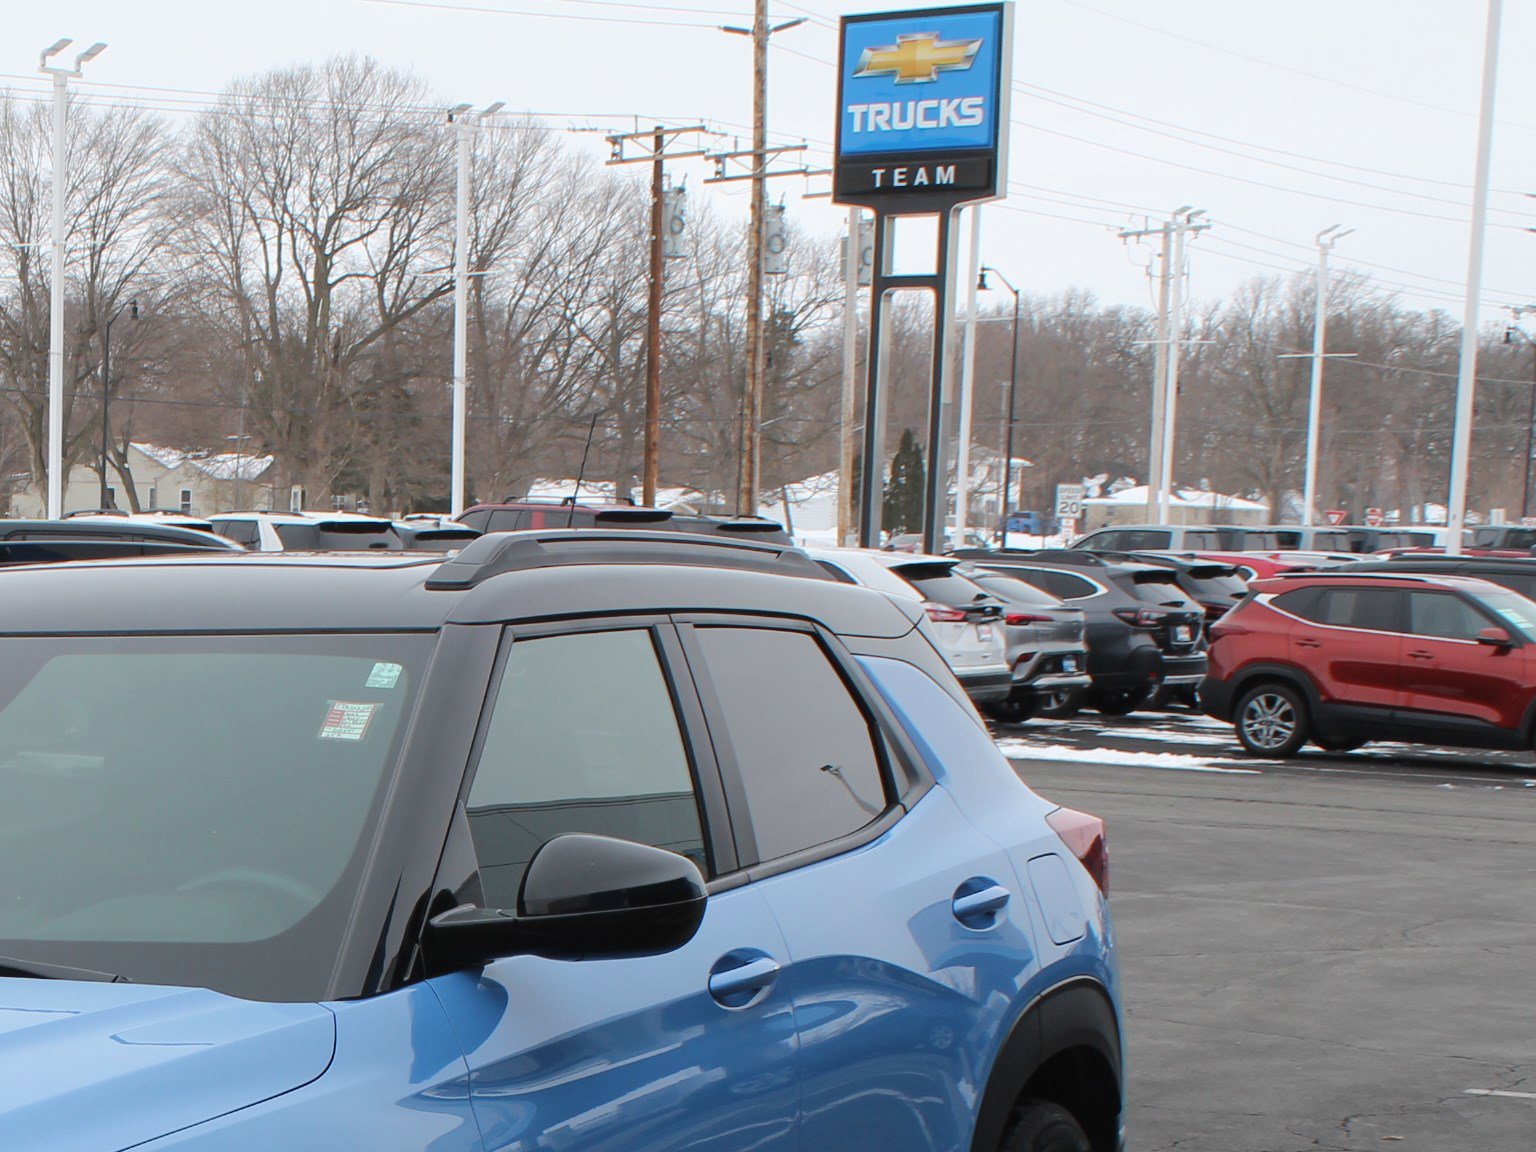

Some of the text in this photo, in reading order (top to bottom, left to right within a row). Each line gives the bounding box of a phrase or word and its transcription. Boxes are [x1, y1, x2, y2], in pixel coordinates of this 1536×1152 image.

[847, 96, 985, 134] TRUCKS
[871, 164, 956, 188] TEAM
[1058, 501, 1079, 514] 20
